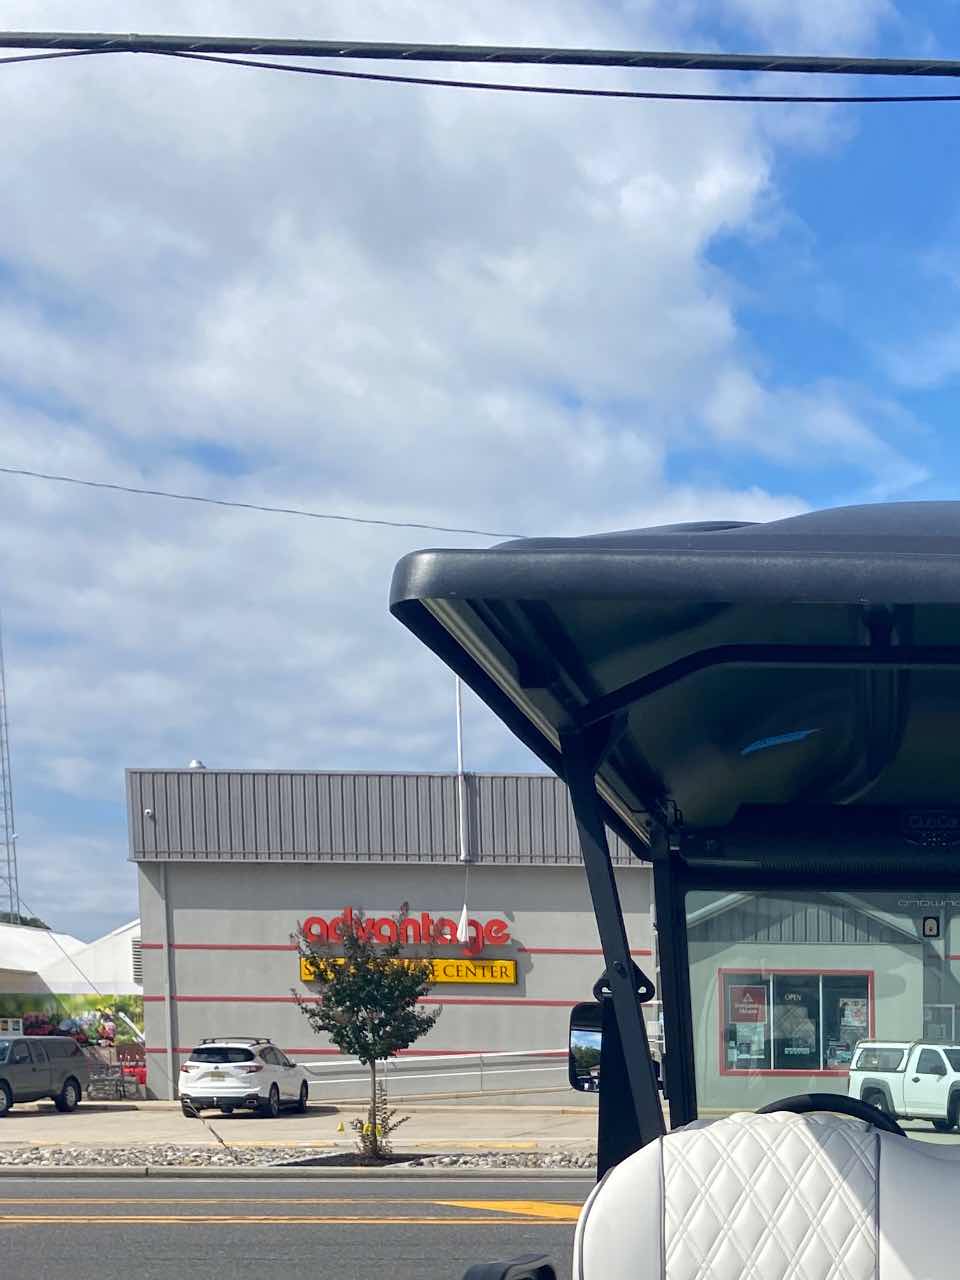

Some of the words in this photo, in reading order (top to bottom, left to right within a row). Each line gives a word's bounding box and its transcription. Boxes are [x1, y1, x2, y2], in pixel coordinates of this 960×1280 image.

[303, 906, 512, 956] advantage
[443, 964, 512, 978] CENTER
[784, 993, 801, 1001] OPEN
